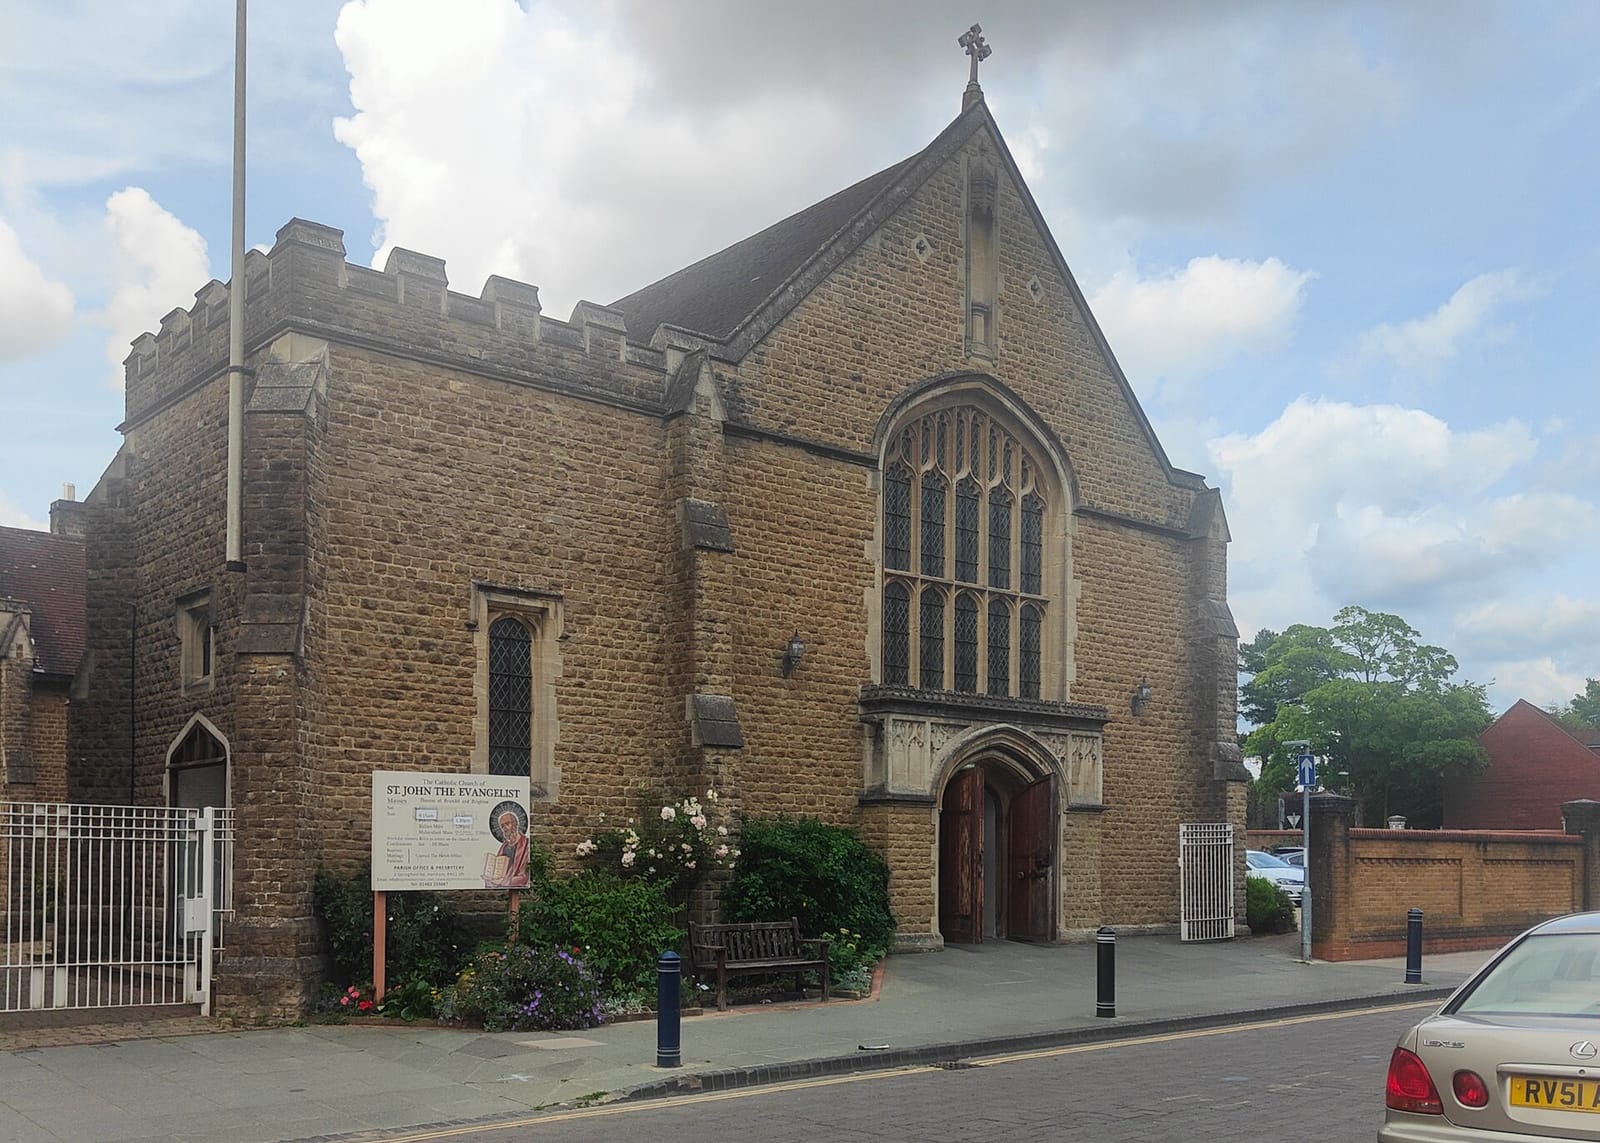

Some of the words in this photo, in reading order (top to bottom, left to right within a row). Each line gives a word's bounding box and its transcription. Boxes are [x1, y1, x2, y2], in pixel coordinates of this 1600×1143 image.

[387, 785, 400, 795] ST.
[402, 786, 432, 796] JOHN
[434, 786, 456, 797] THE
[459, 787, 521, 798] EVANGELIST
[1423, 1039, 1465, 1049] LEXUS
[1525, 1079, 1584, 1107] RV51
